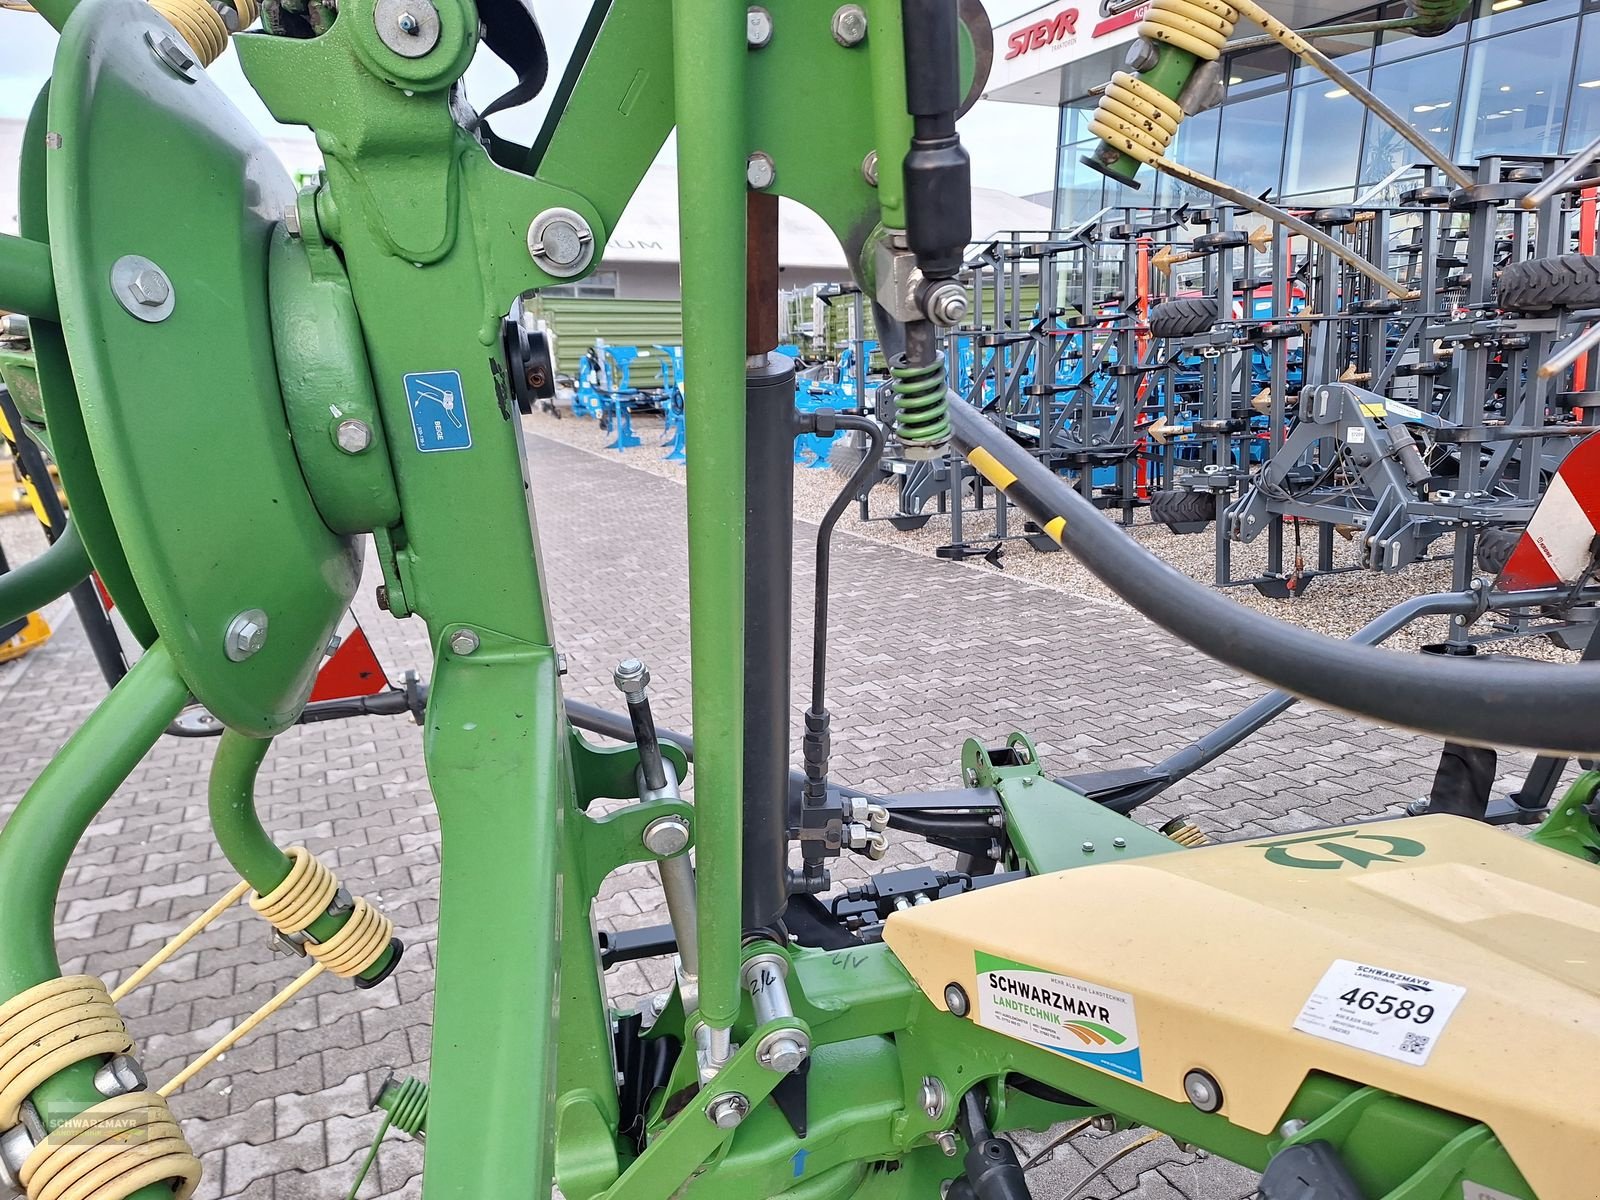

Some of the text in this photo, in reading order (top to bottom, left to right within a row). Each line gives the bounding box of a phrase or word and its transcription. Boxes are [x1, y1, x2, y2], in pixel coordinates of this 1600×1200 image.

[1004, 7, 1079, 60] STEYR
[434, 420, 445, 441] BEIGE
[1050, 977, 1065, 986] MEHR
[1076, 985, 1088, 993] NUR
[1354, 972, 1396, 985] LANDTECHNIK
[1356, 965, 1431, 986] SCHWARZMAYR
[989, 973, 1111, 1024] SCHWARZMAYR
[992, 994, 1062, 1026] LANDTECHNIK
[1339, 987, 1435, 1025] 46589
